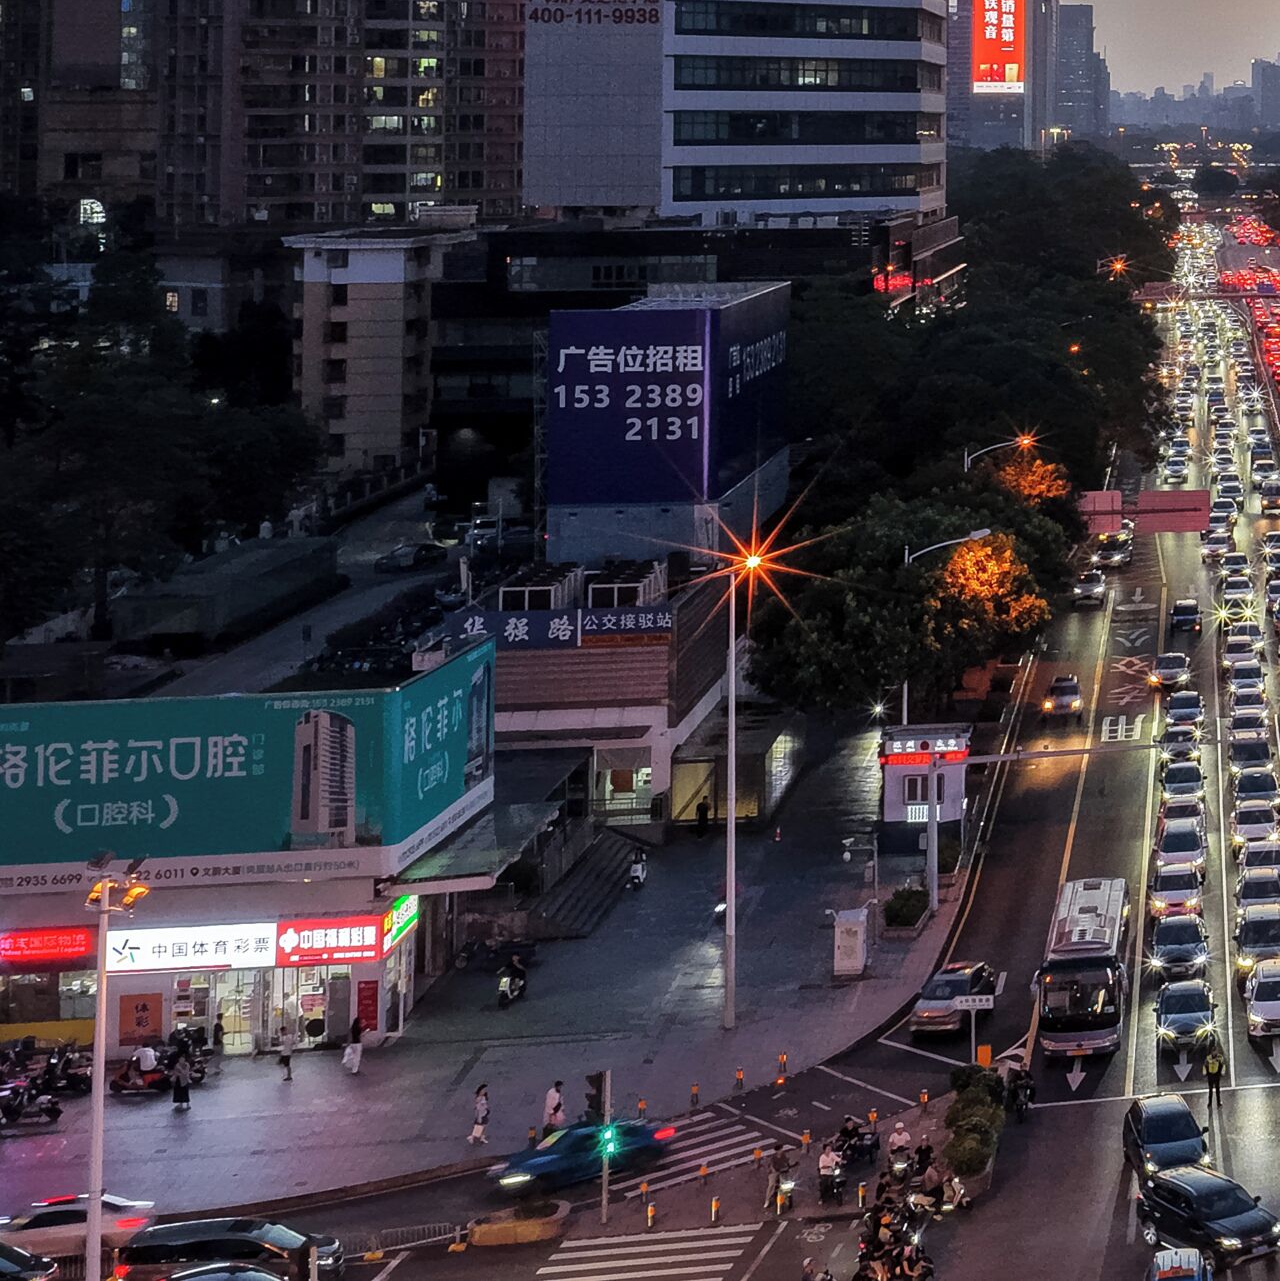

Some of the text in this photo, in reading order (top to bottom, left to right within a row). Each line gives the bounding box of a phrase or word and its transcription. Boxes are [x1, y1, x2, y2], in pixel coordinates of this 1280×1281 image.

[529, 8, 660, 24] 400-111-9938
[557, 345, 704, 373] 广告位招租
[554, 383, 703, 408] 153 2389
[625, 416, 699, 441] 2131
[583, 613, 672, 630] 公交接驳站
[16, 874, 47, 887] 2935
[51, 873, 82, 886] 6699
[151, 936, 270, 959] 中国体育彩票
